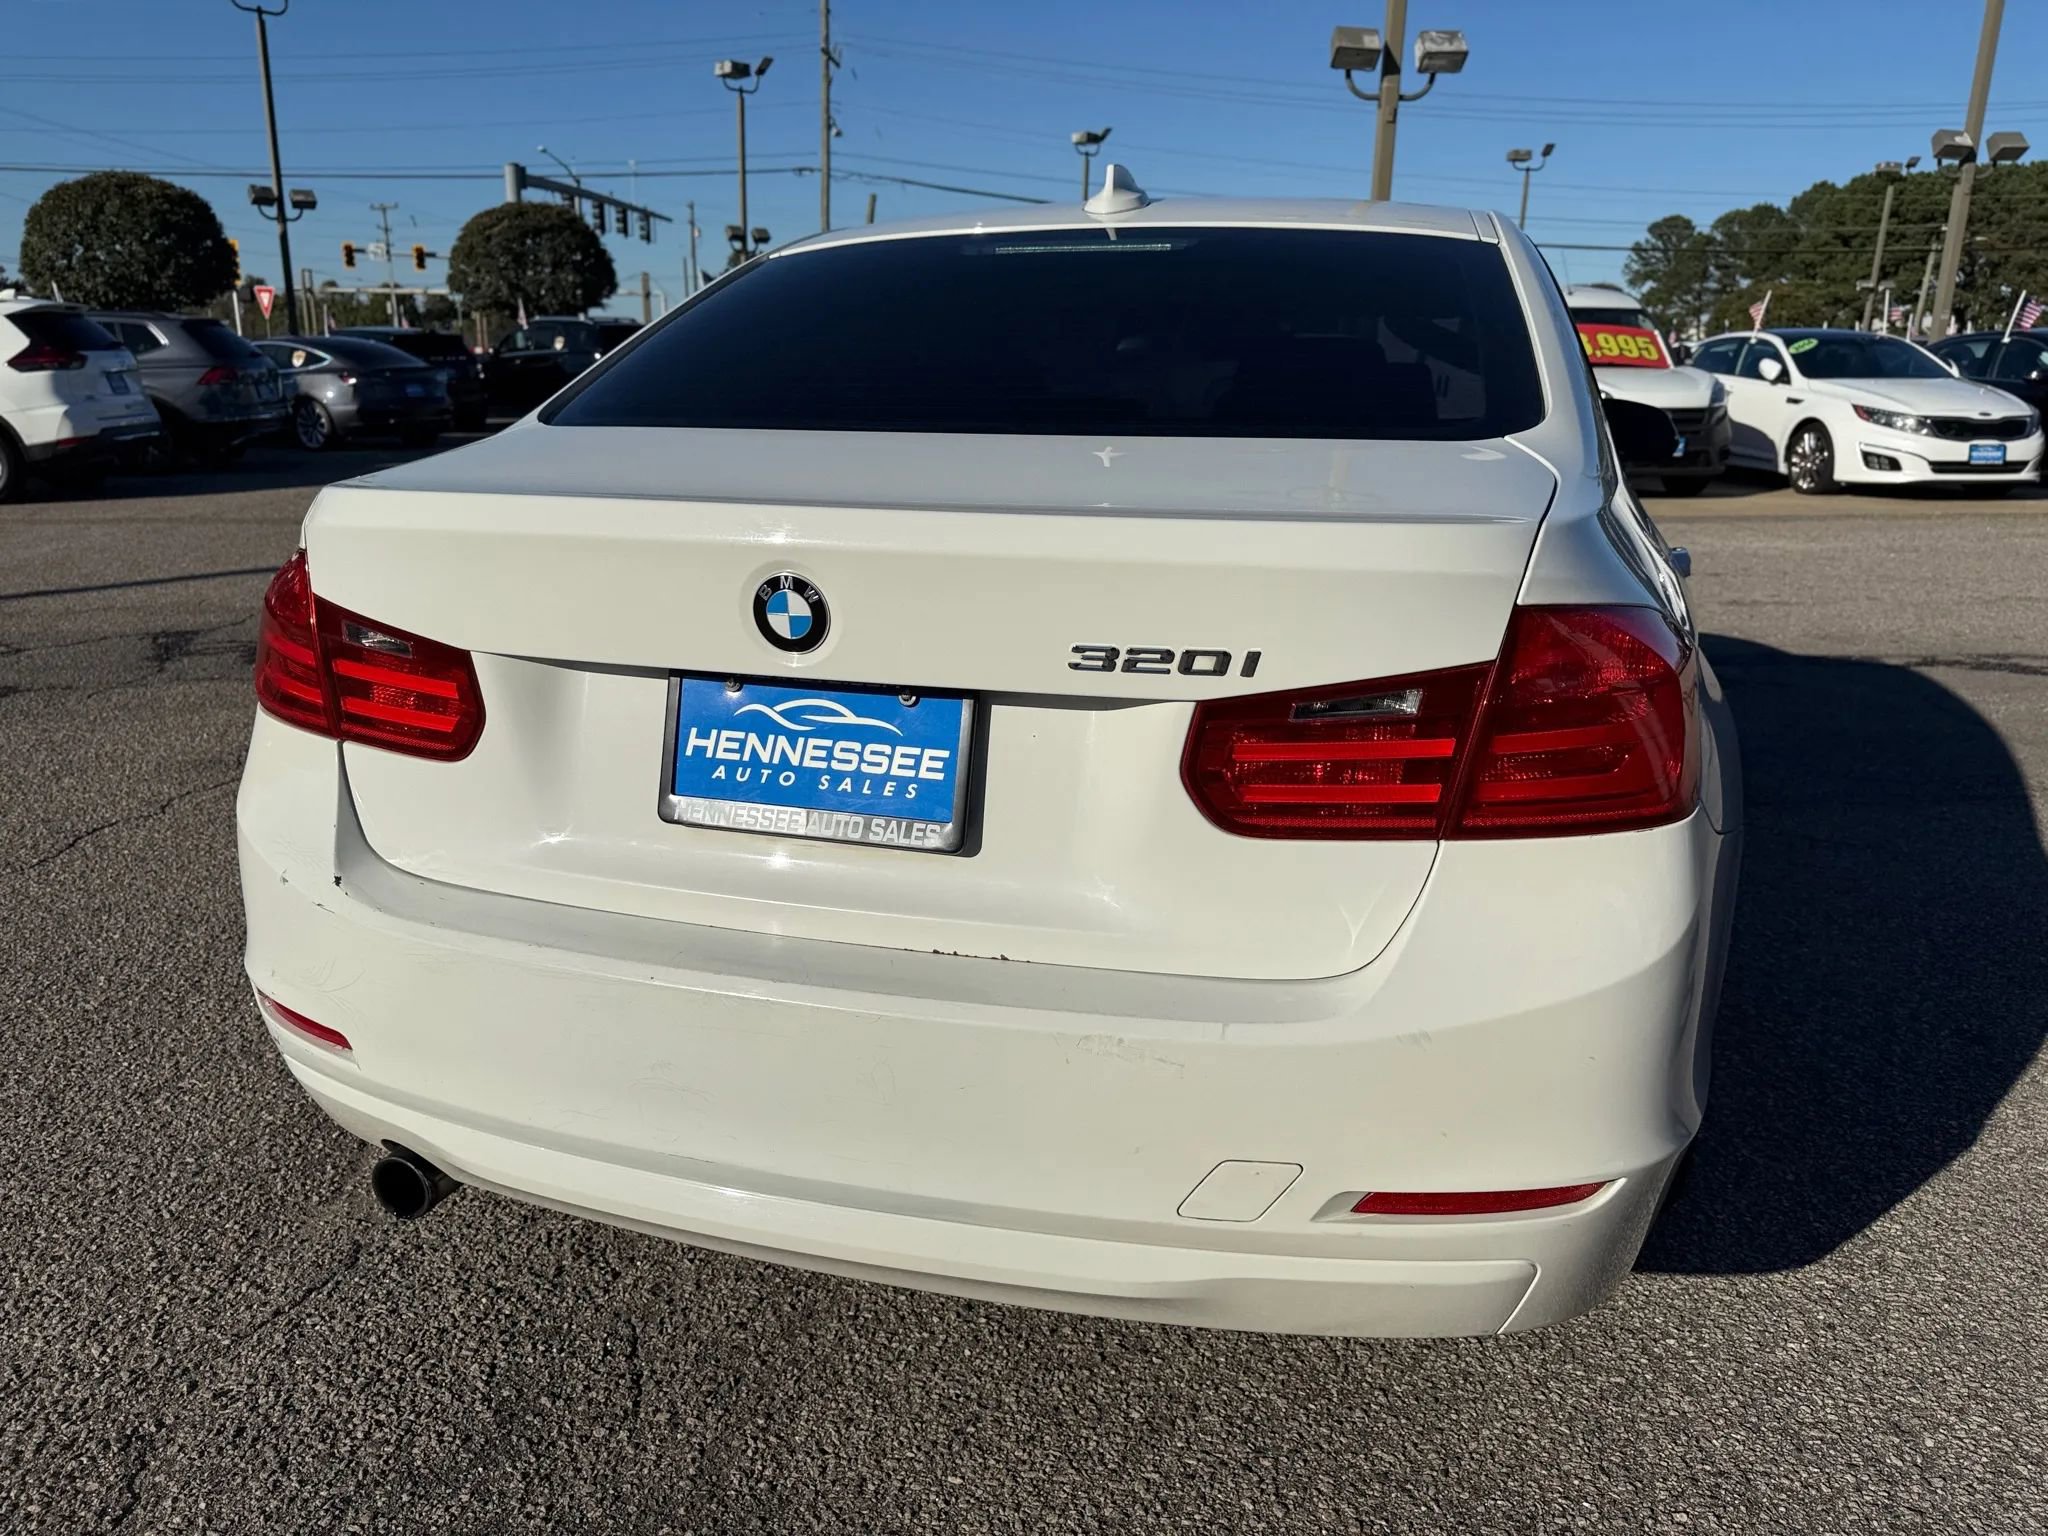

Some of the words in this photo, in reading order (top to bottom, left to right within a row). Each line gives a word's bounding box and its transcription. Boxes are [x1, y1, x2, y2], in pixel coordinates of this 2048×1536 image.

[758, 576, 819, 603] BMW
[685, 727, 950, 780] HENNESSEE
[712, 765, 796, 786] AUTO
[818, 774, 918, 799] SALES
[674, 799, 802, 834] HENNESSEE
[806, 812, 864, 839] AUTO
[869, 820, 942, 847] SALES
